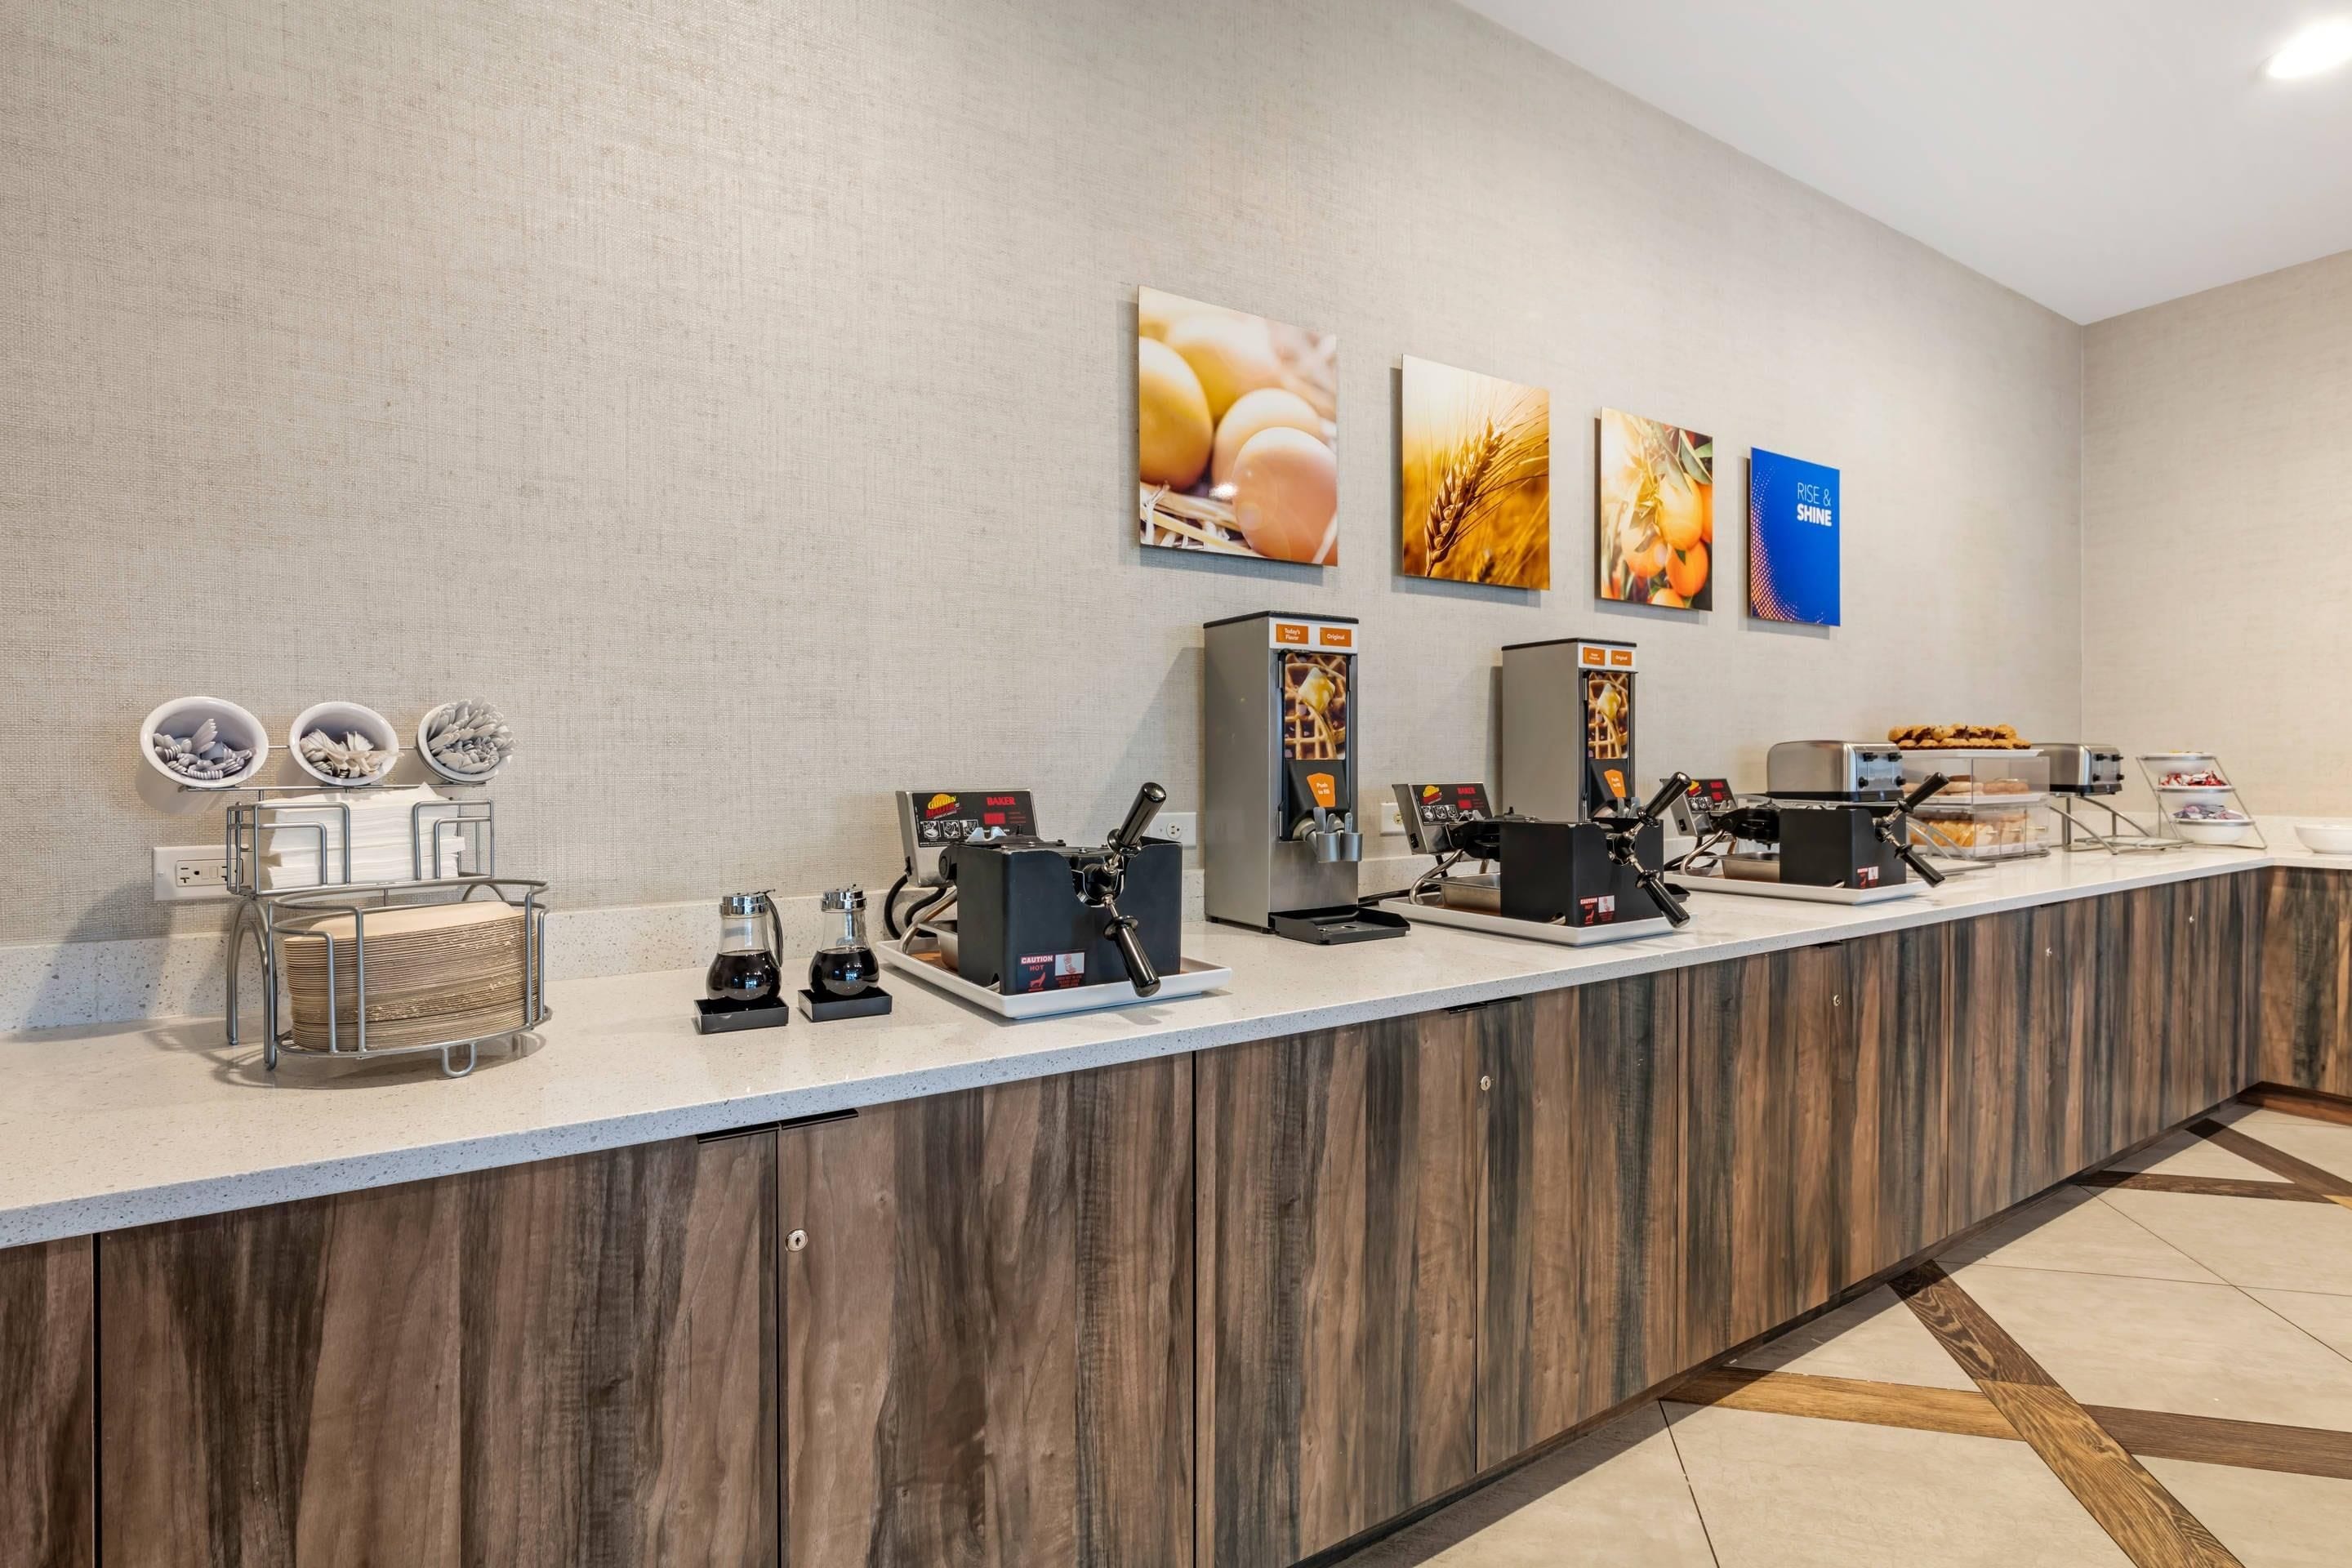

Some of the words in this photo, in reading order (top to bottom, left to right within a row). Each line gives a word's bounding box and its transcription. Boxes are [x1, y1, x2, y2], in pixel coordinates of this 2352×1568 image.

[1797, 482, 1820, 505] RISE
[1823, 488, 1832, 506] &
[1797, 503, 1833, 527] SHINE
[1285, 627, 1301, 635] Today's
[1326, 633, 1345, 641] Original
[987, 796, 1016, 806] BAKER
[1020, 955, 1054, 964] CAUTION
